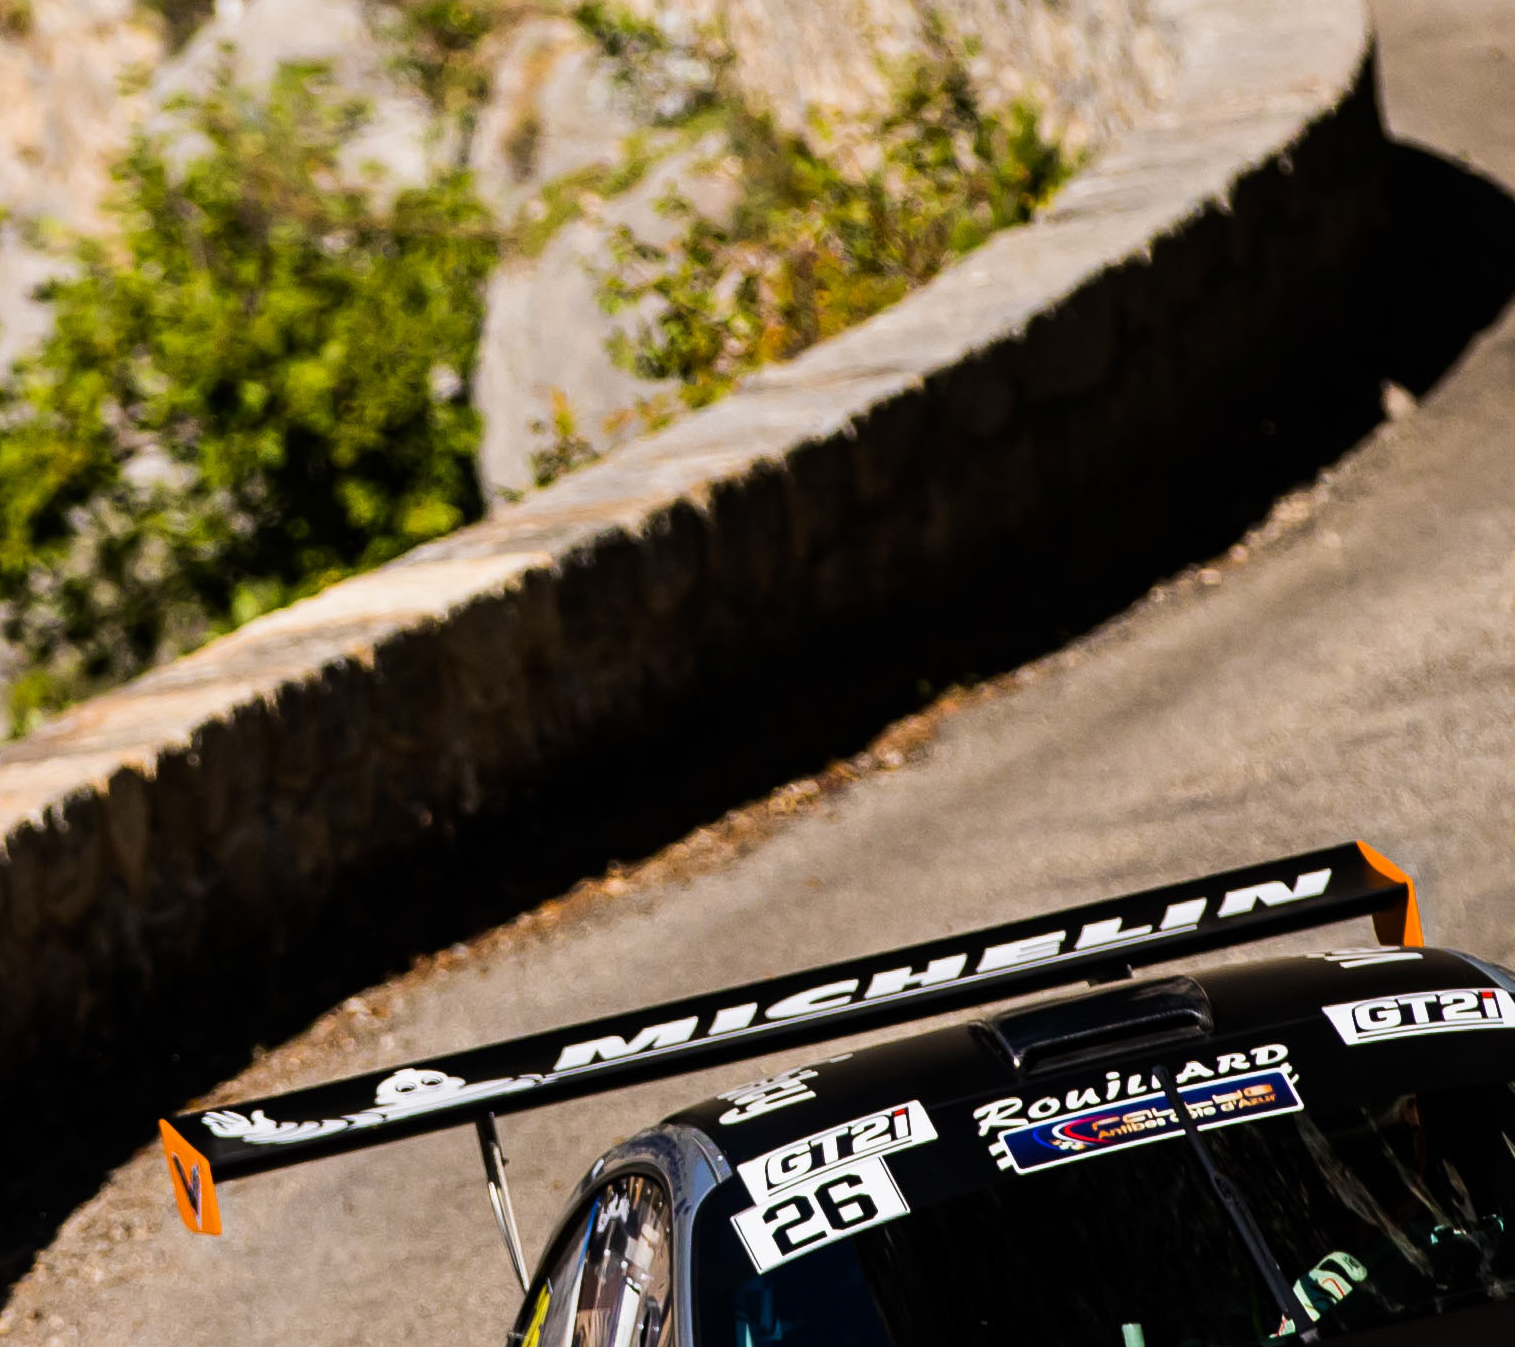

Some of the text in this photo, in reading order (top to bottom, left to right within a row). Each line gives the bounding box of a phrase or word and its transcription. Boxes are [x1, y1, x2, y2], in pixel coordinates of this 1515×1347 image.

[553, 867, 1332, 1072] MICHELIN
[1351, 989, 1501, 1032] GT2i
[764, 1107, 912, 1191] GT2i
[761, 1173, 879, 1257] 26
